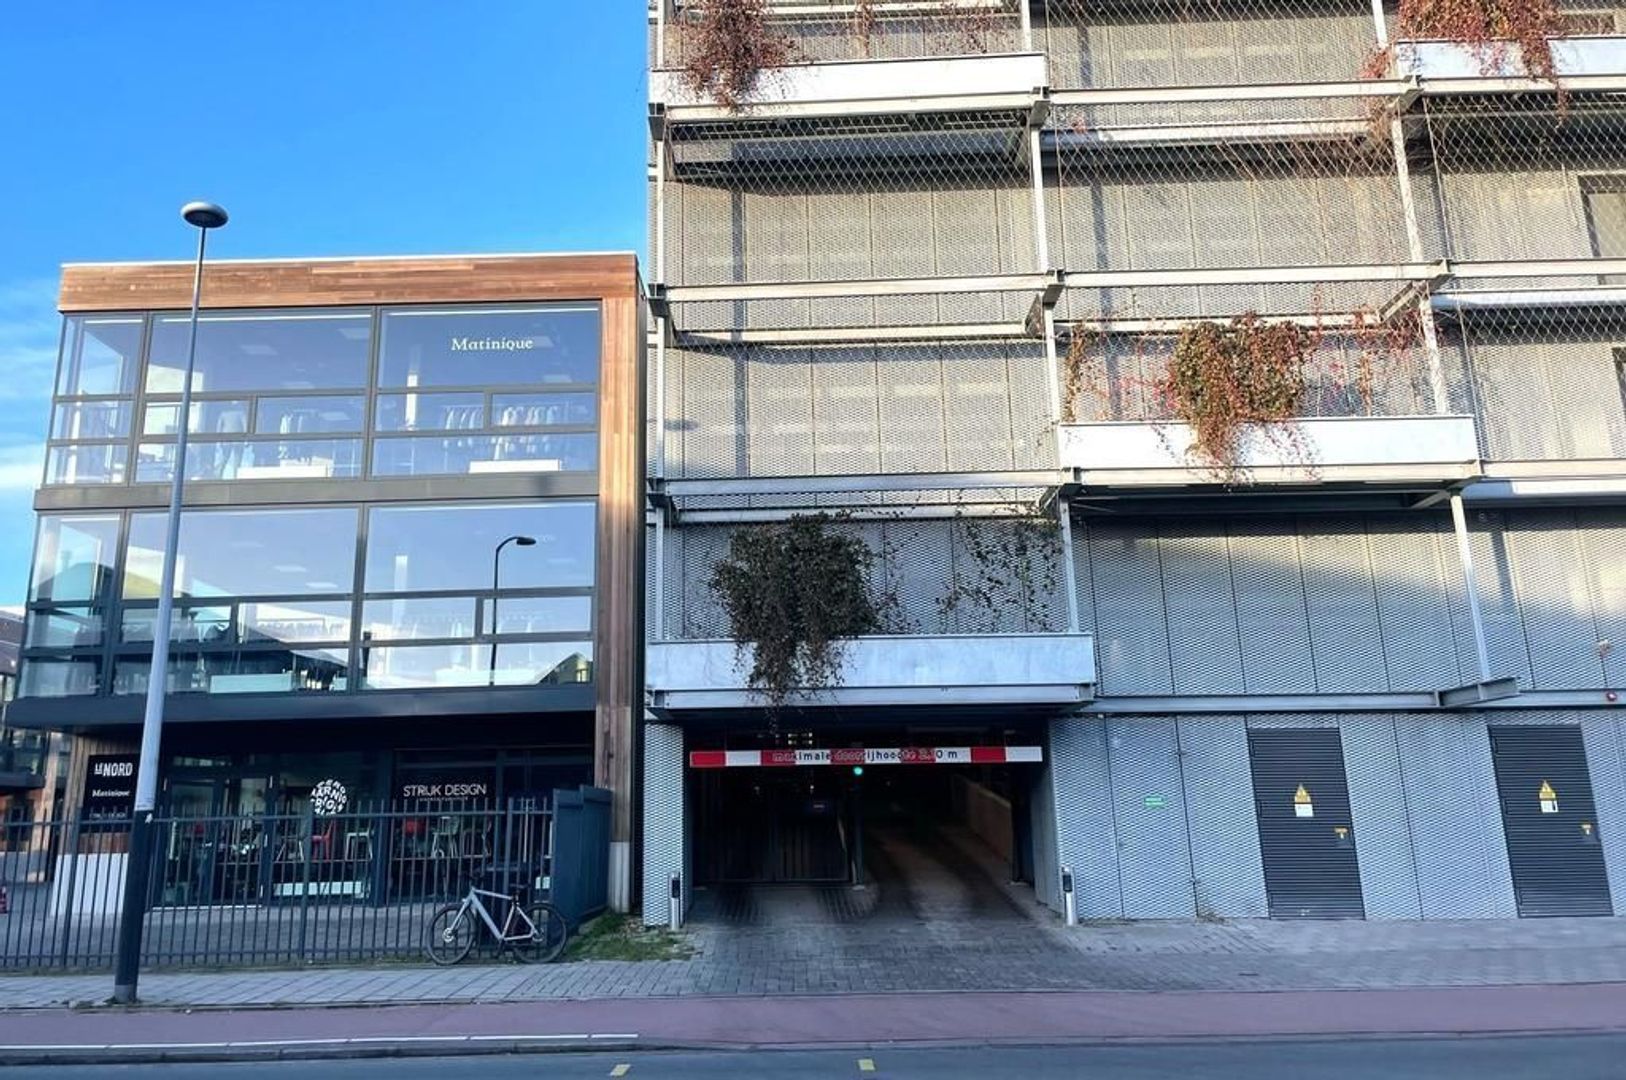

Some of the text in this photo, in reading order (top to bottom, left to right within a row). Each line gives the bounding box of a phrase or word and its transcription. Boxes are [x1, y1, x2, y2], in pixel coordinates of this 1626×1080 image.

[451, 337, 534, 351] Matinique
[948, 750, 958, 759] m
[103, 762, 133, 777] NORD
[444, 783, 487, 796] DESIGN
